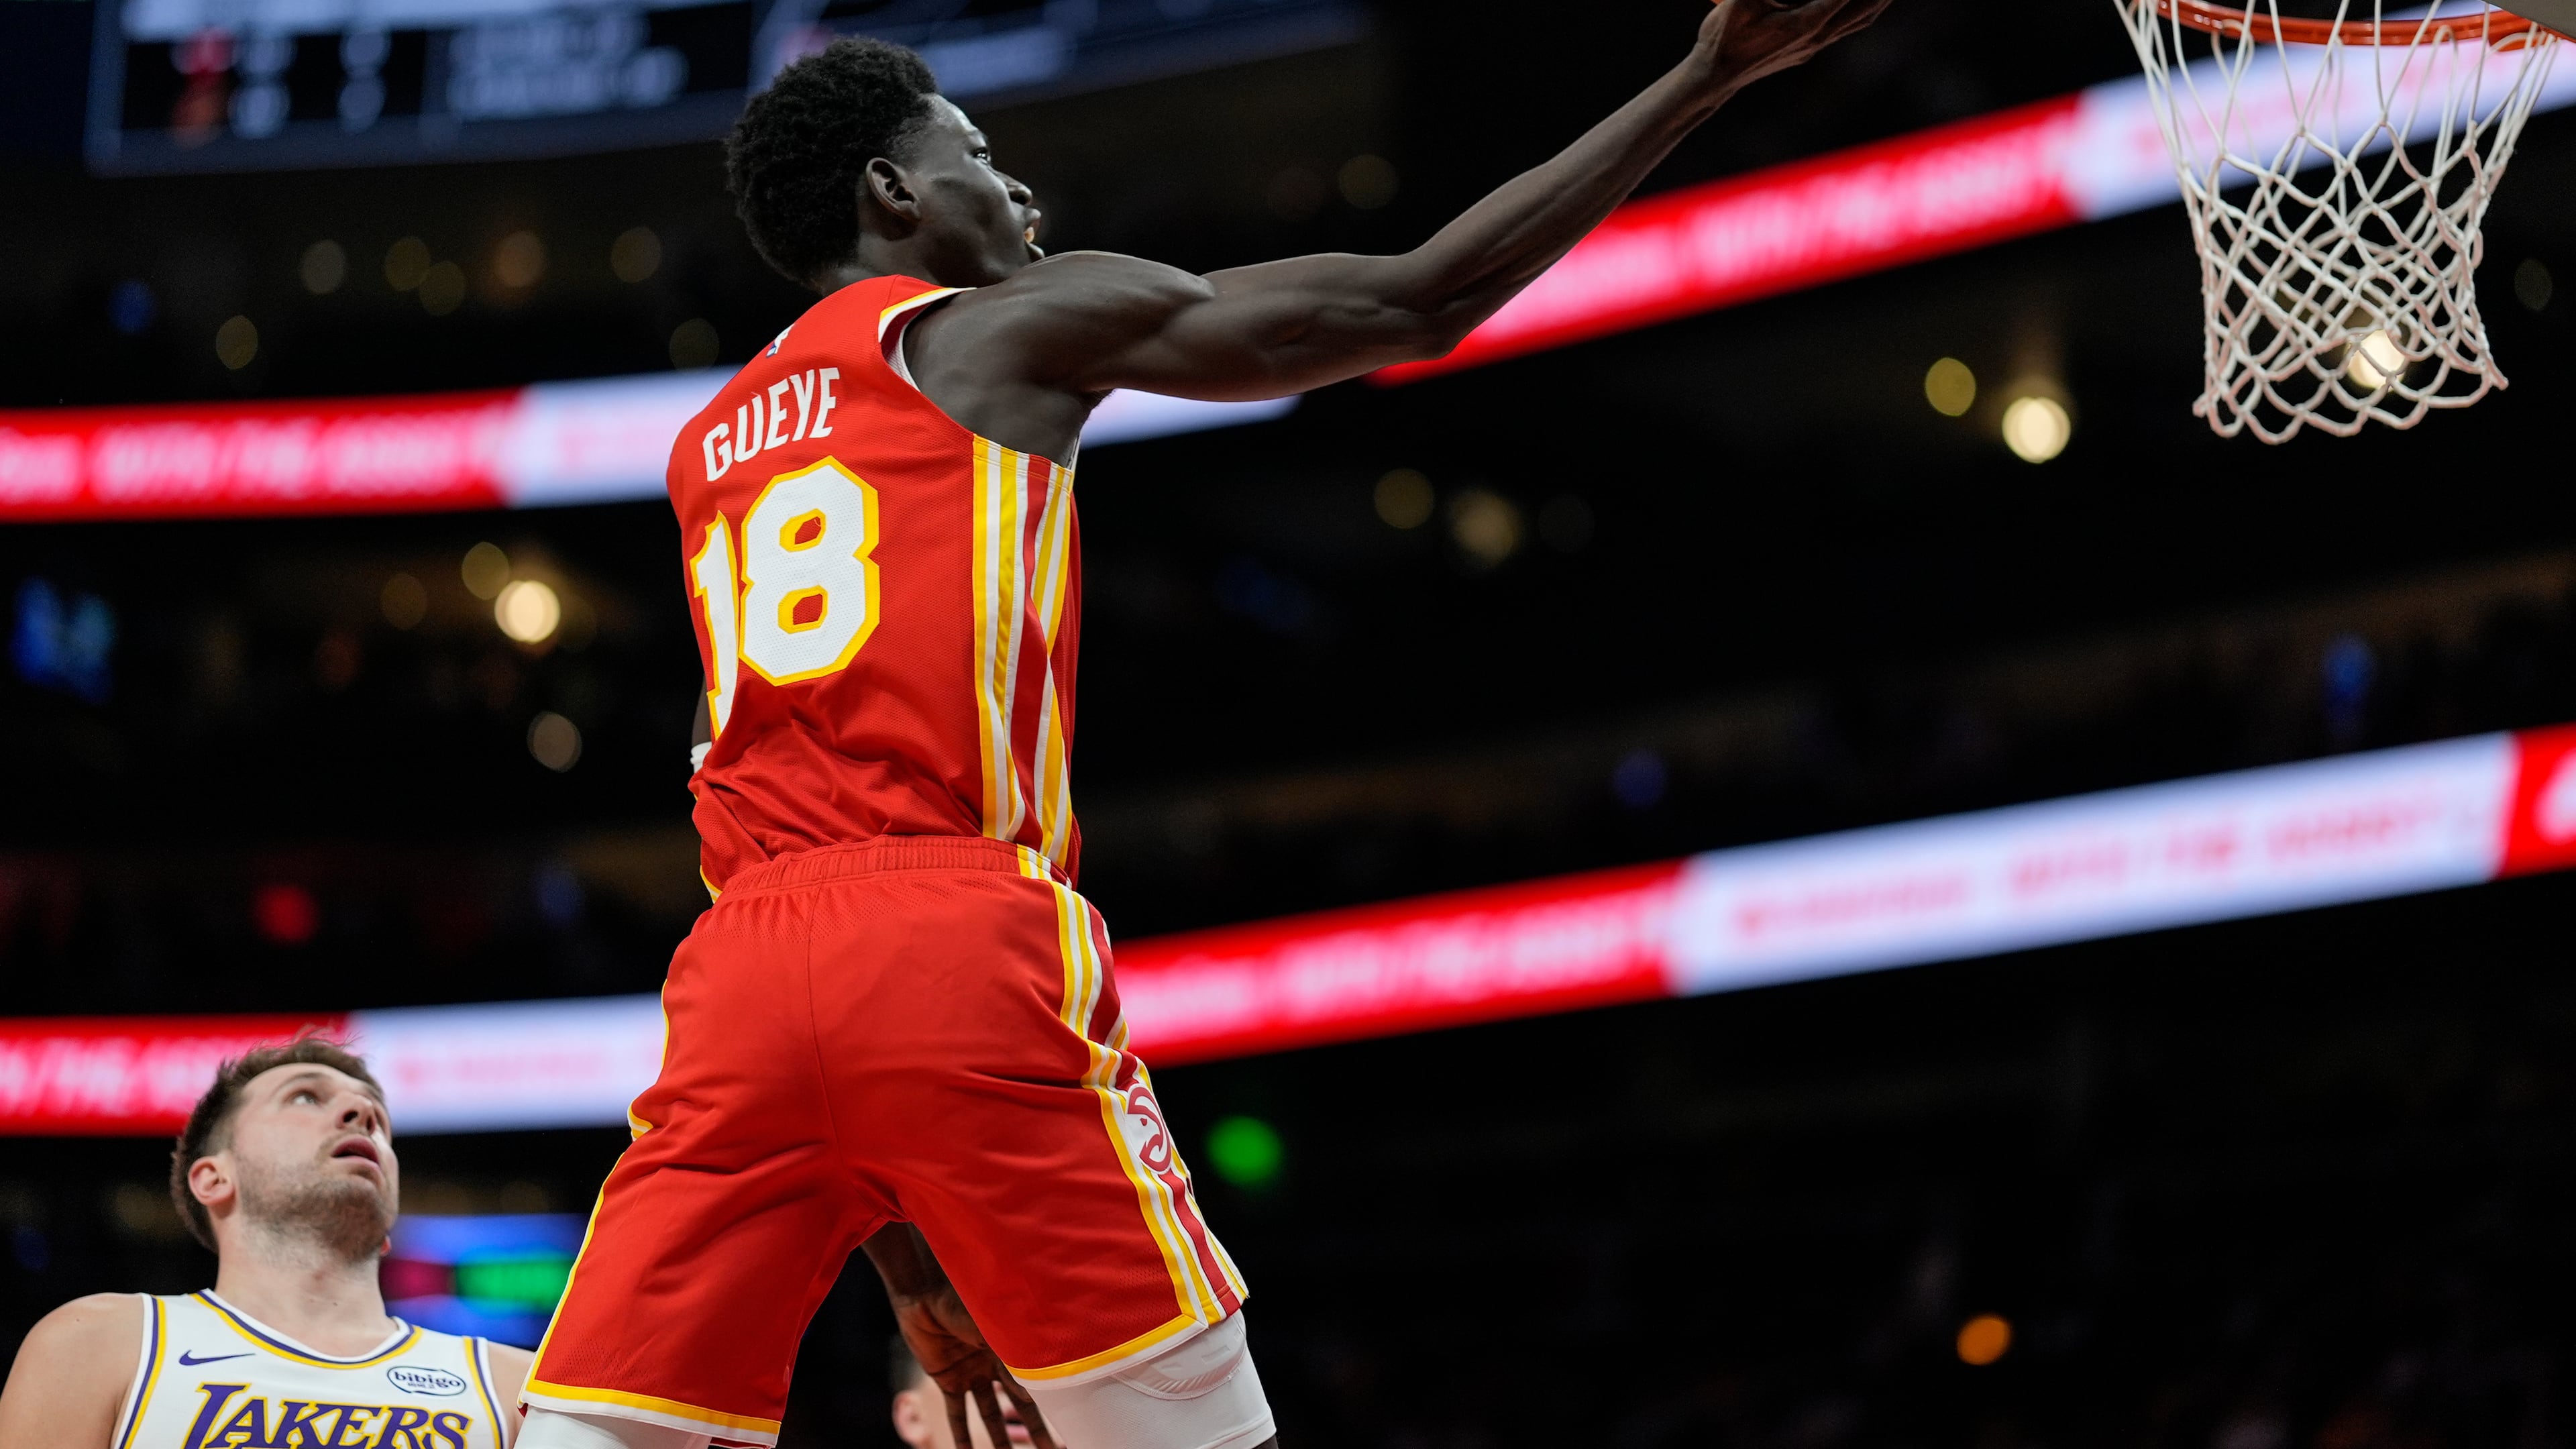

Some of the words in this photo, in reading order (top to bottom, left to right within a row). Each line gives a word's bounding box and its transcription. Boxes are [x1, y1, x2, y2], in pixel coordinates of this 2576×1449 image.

[702, 366, 841, 482] GUEYE
[690, 455, 880, 741] 18
[180, 1381, 474, 1449] LAKERS
[394, 1371, 461, 1389] bibigo
